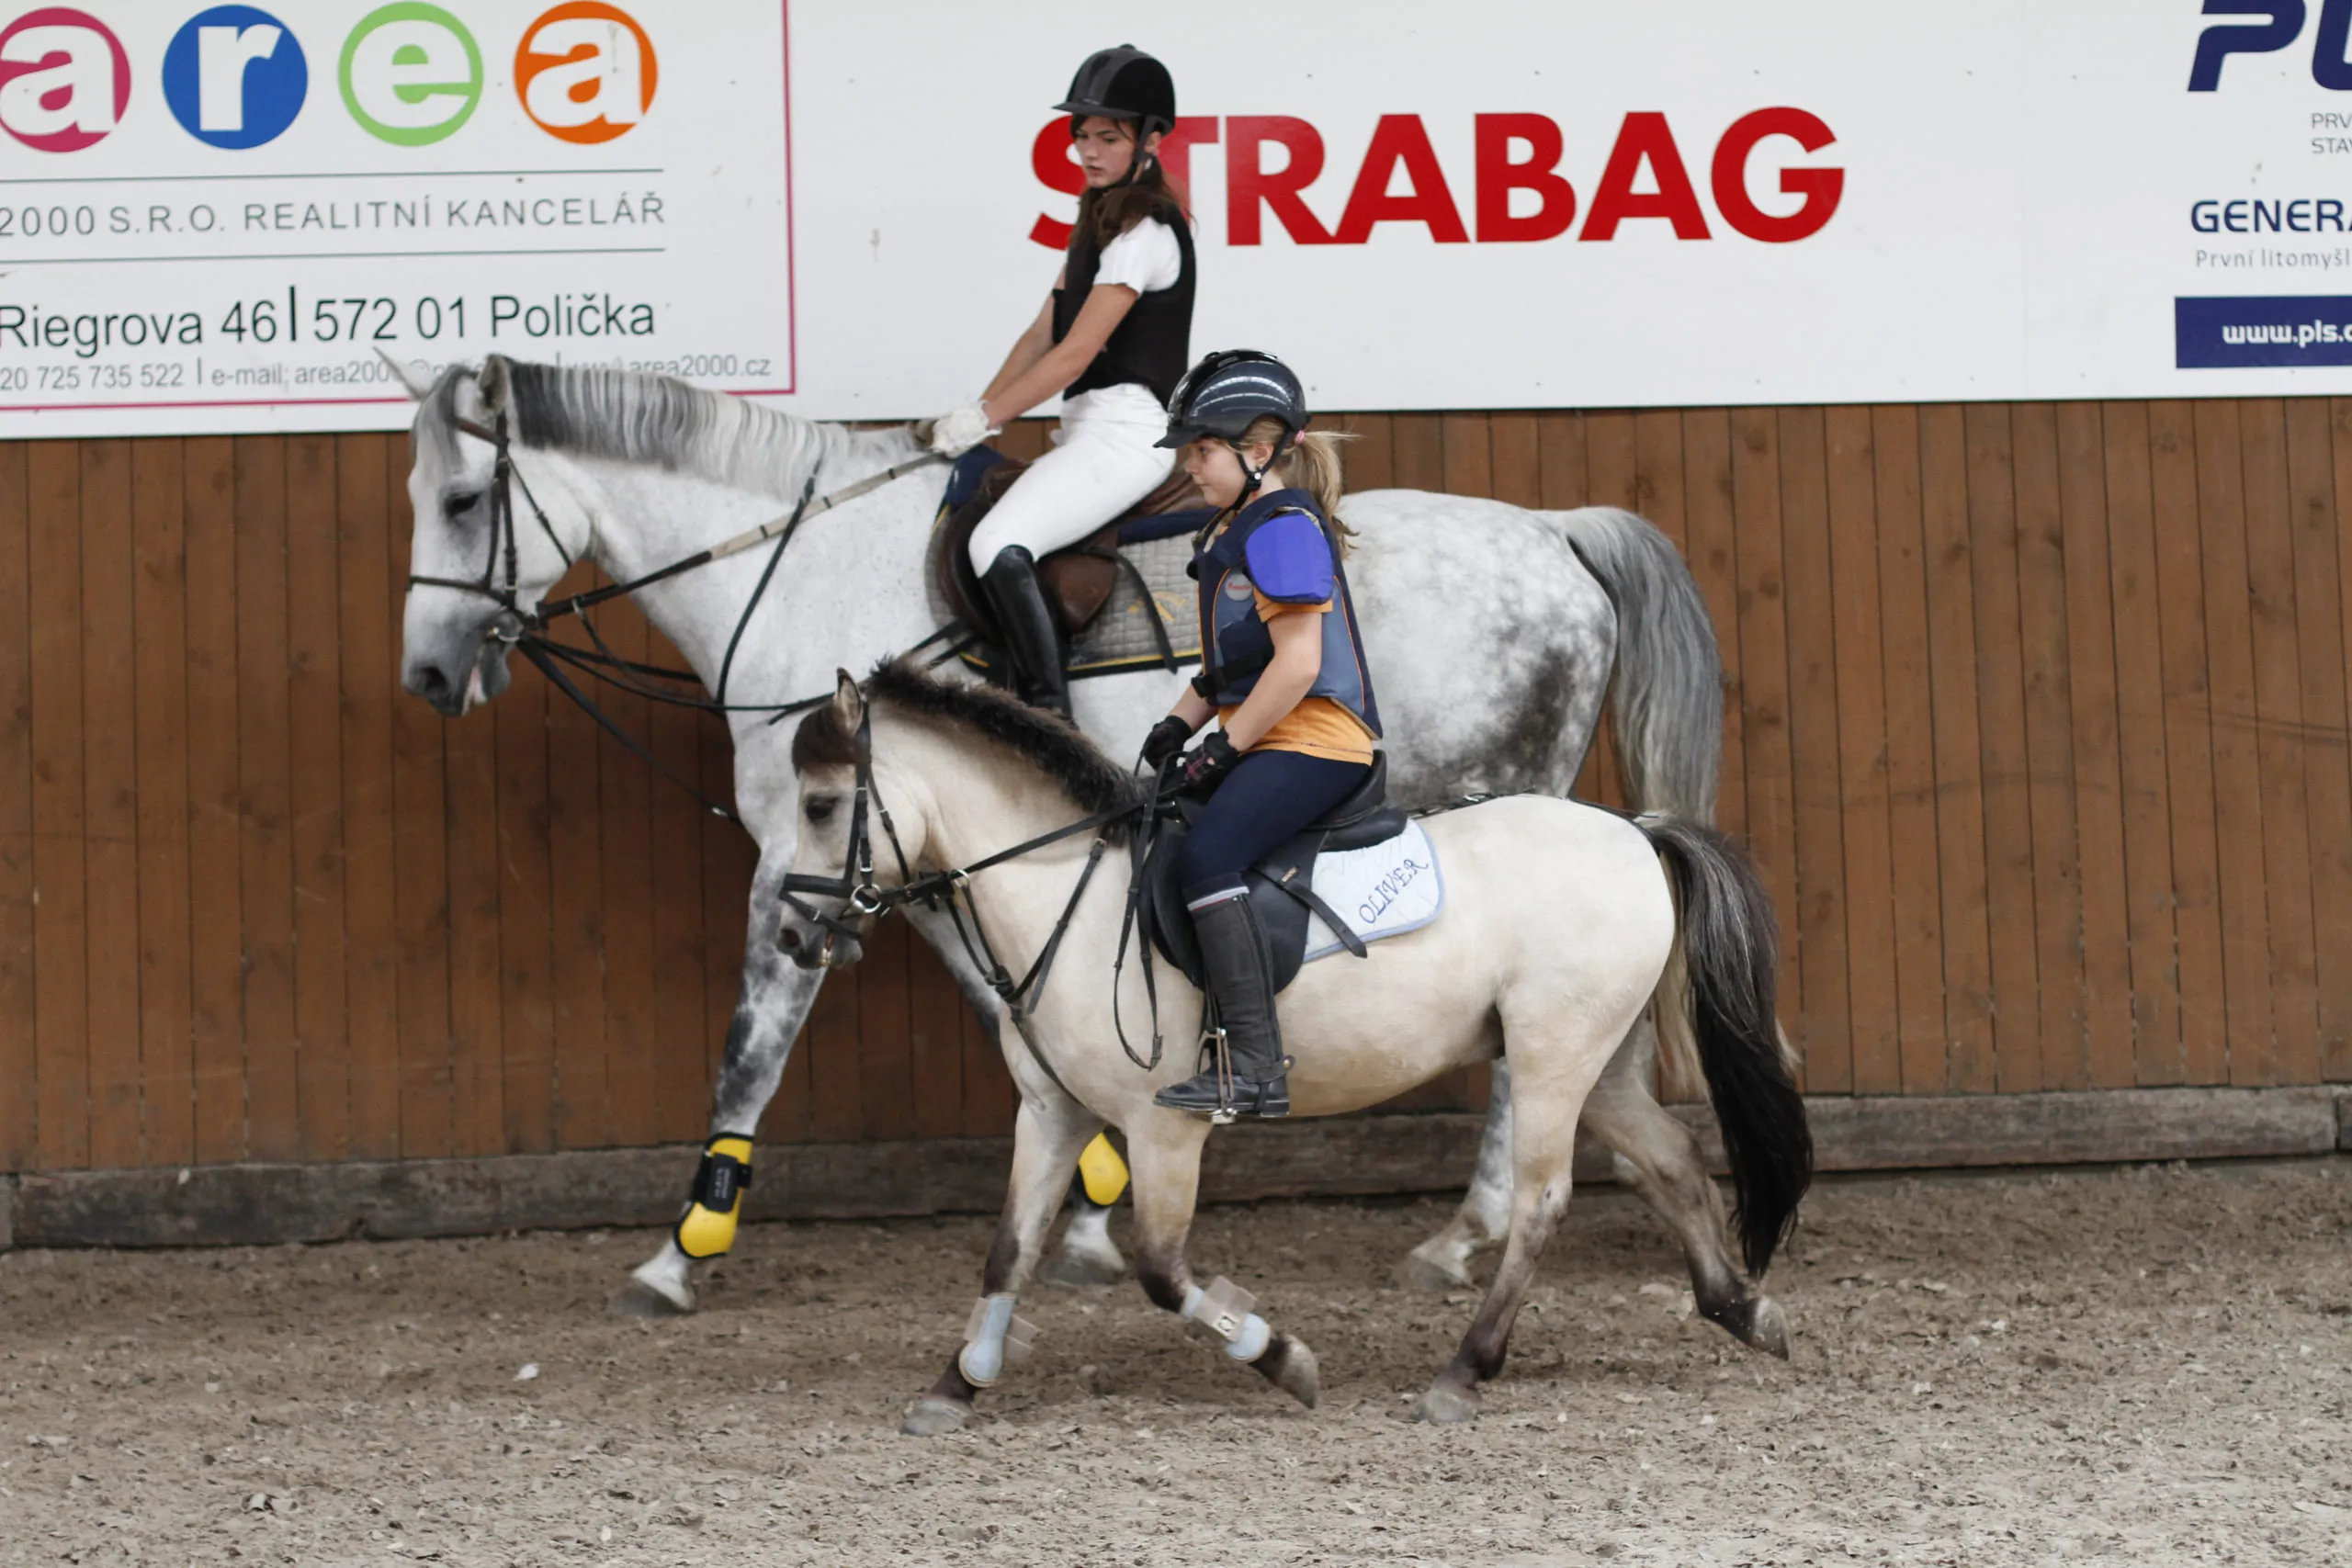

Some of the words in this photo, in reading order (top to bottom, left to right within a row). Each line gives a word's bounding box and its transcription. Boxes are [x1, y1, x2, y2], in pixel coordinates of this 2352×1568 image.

[2312, 137, 2352, 154] STA
[0, 206, 95, 237] 2000
[108, 204, 225, 233] S.R.O.
[244, 194, 431, 231] REALITNÍ
[447, 191, 666, 228] KANCELÁŘ
[2191, 198, 2352, 232] GENER
[2196, 247, 2253, 268] První
[0, 304, 203, 358] Riegrova
[220, 300, 277, 344] 46
[313, 298, 398, 342] 572
[416, 296, 465, 340] 01
[491, 292, 655, 337] Polička
[37, 365, 80, 389] 725
[89, 364, 132, 389] 735
[141, 363, 184, 388] 522
[1359, 858, 1429, 924] OLIVER
